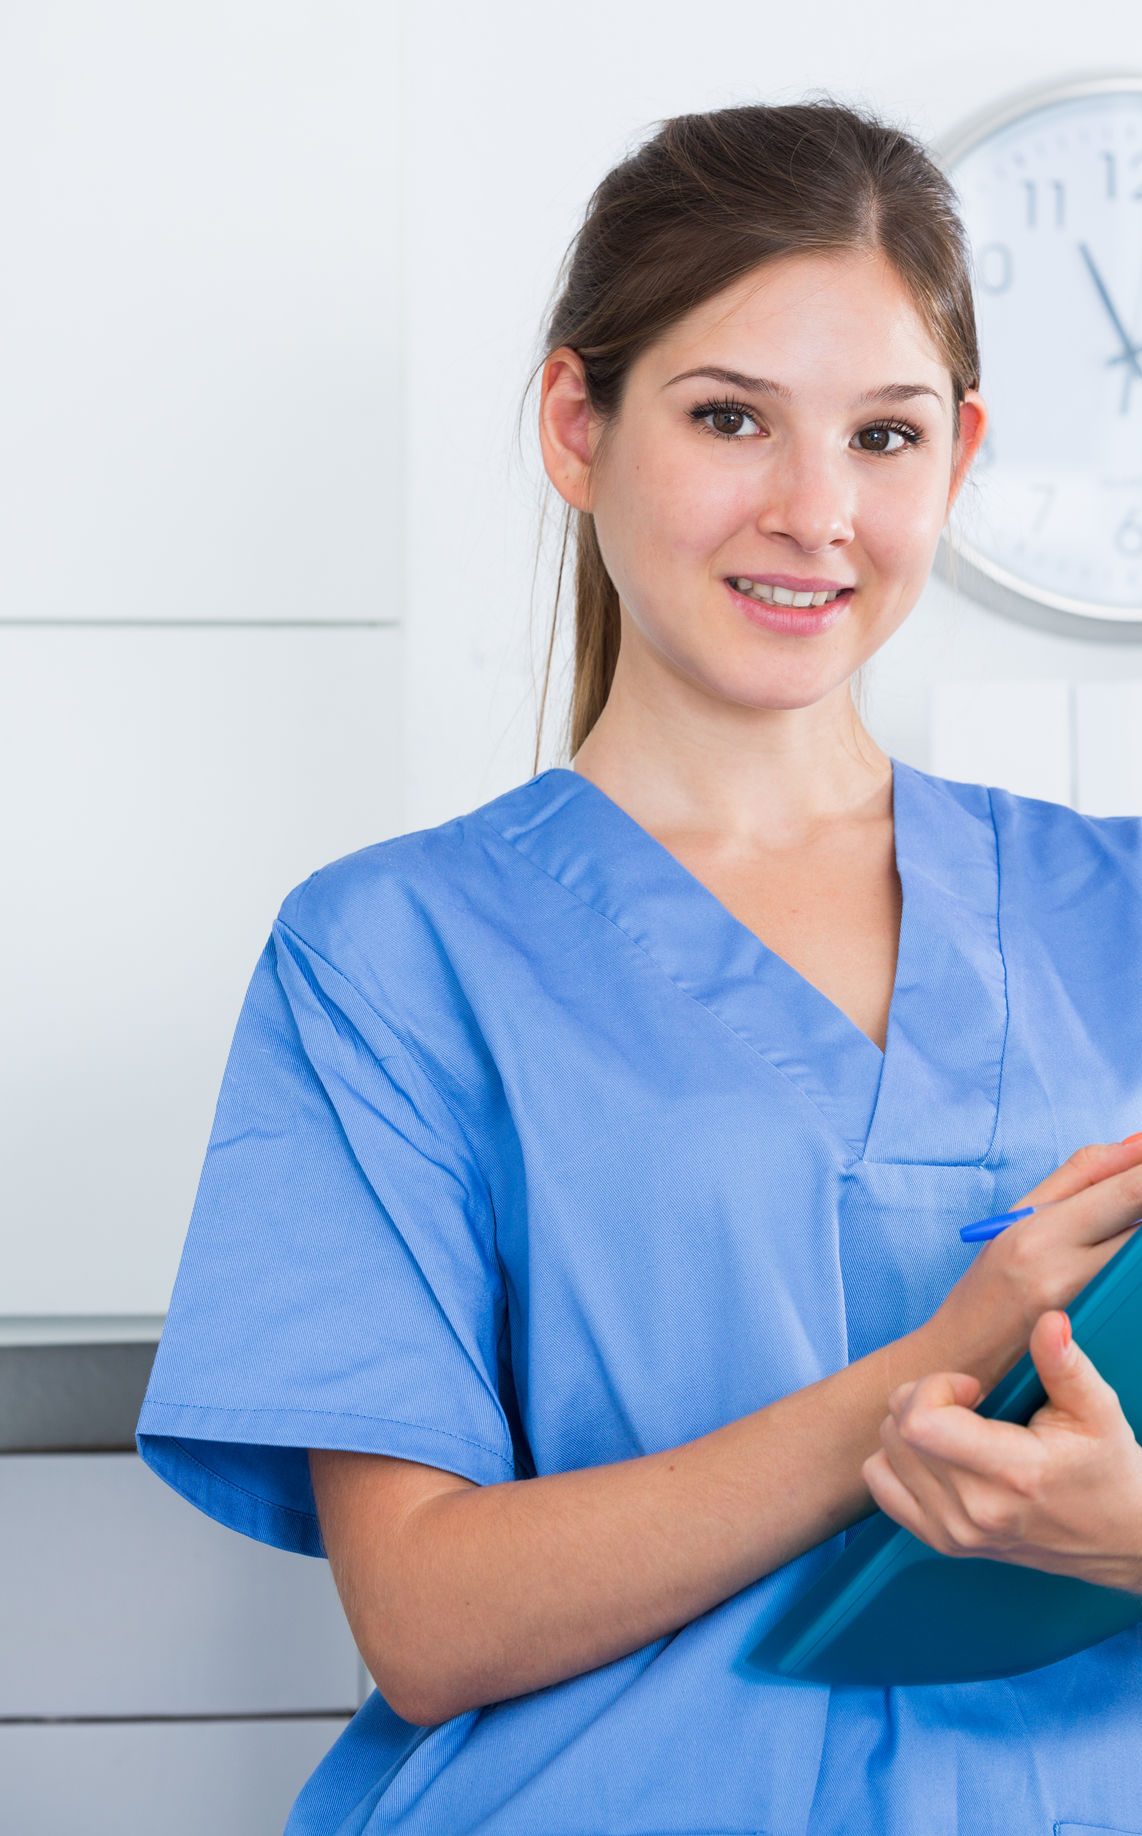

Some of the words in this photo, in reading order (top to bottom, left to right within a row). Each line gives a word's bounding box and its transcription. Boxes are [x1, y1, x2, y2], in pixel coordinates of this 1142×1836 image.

[1021, 178, 1066, 230] 11
[978, 242, 1014, 297] 0
[1027, 483, 1057, 536] 7
